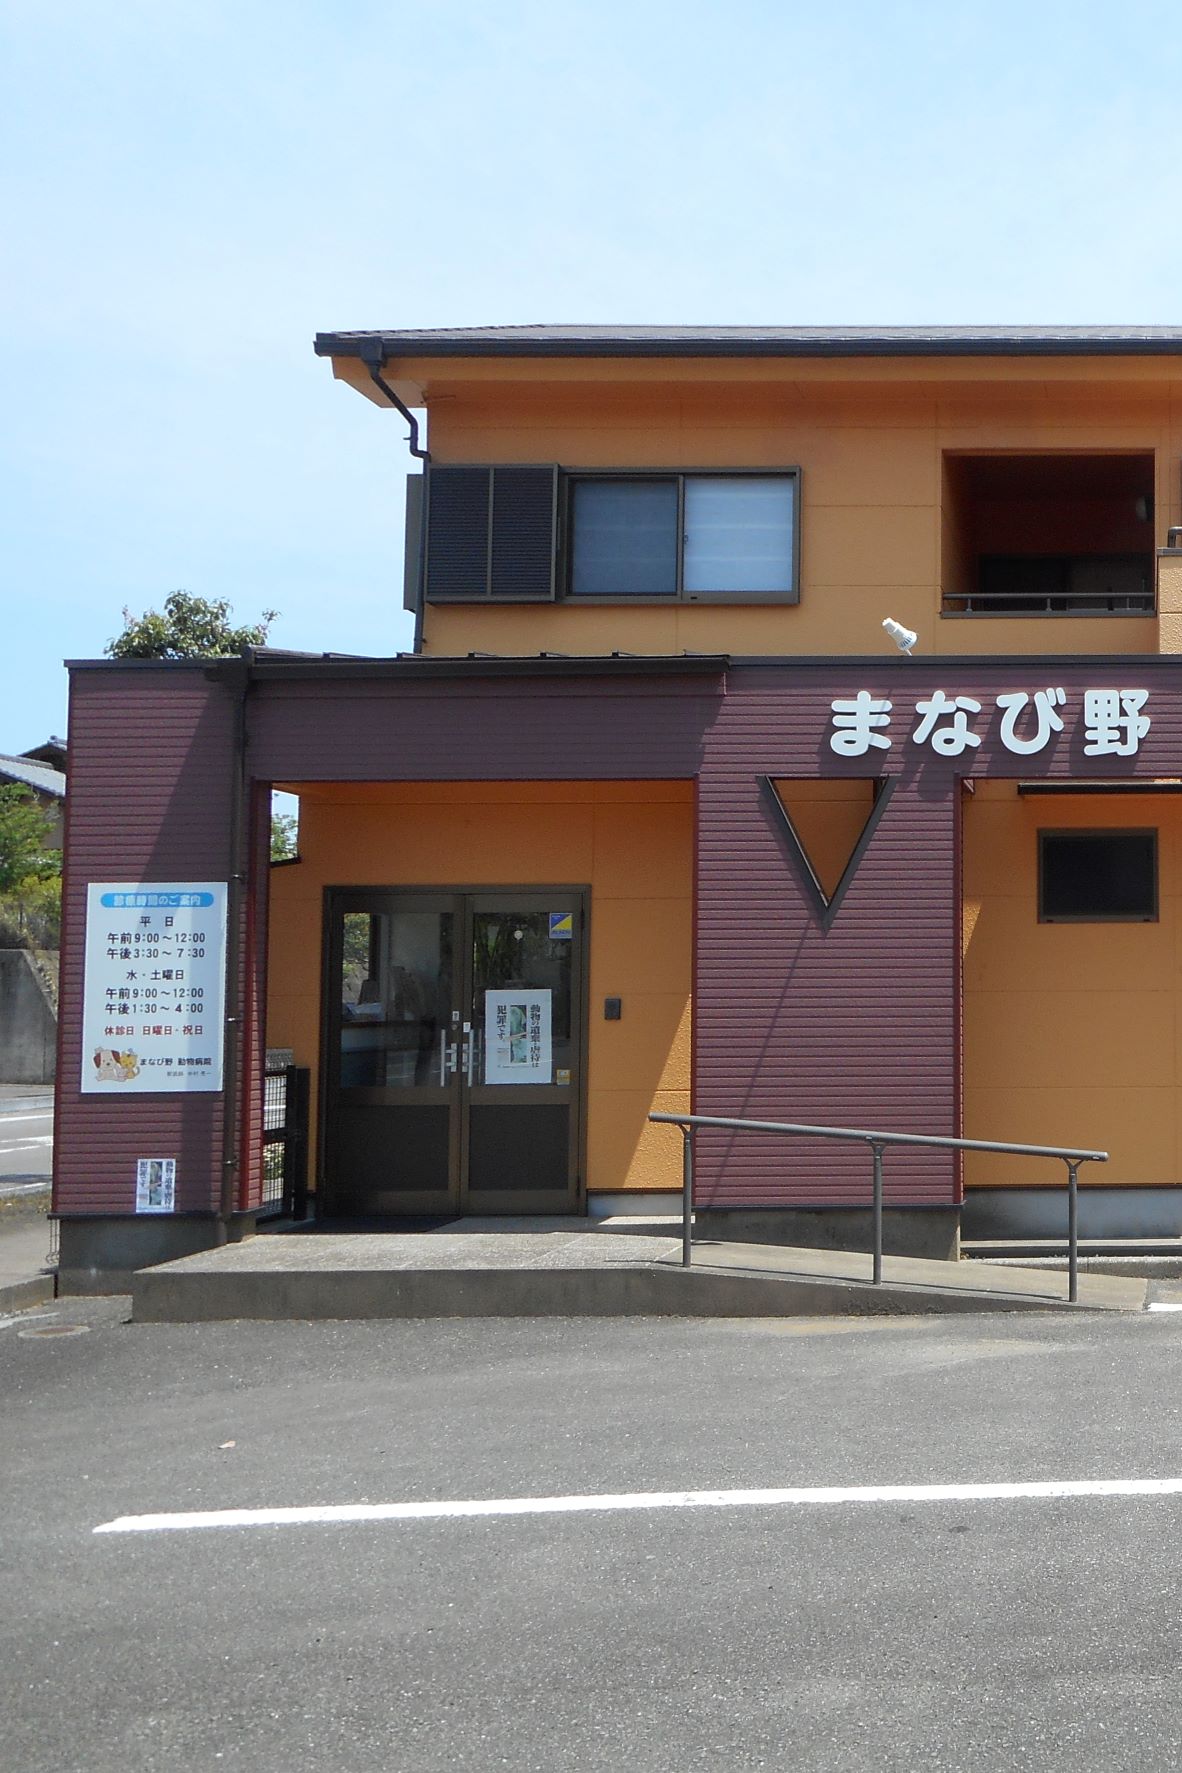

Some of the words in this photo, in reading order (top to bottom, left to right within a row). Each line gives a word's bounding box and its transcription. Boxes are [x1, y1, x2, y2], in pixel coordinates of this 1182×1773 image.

[830, 687, 1150, 756] まなび野
[104, 1026, 134, 1036] 休診日
[140, 1058, 173, 1066] まなび野
[177, 1058, 212, 1066] 動物病院
